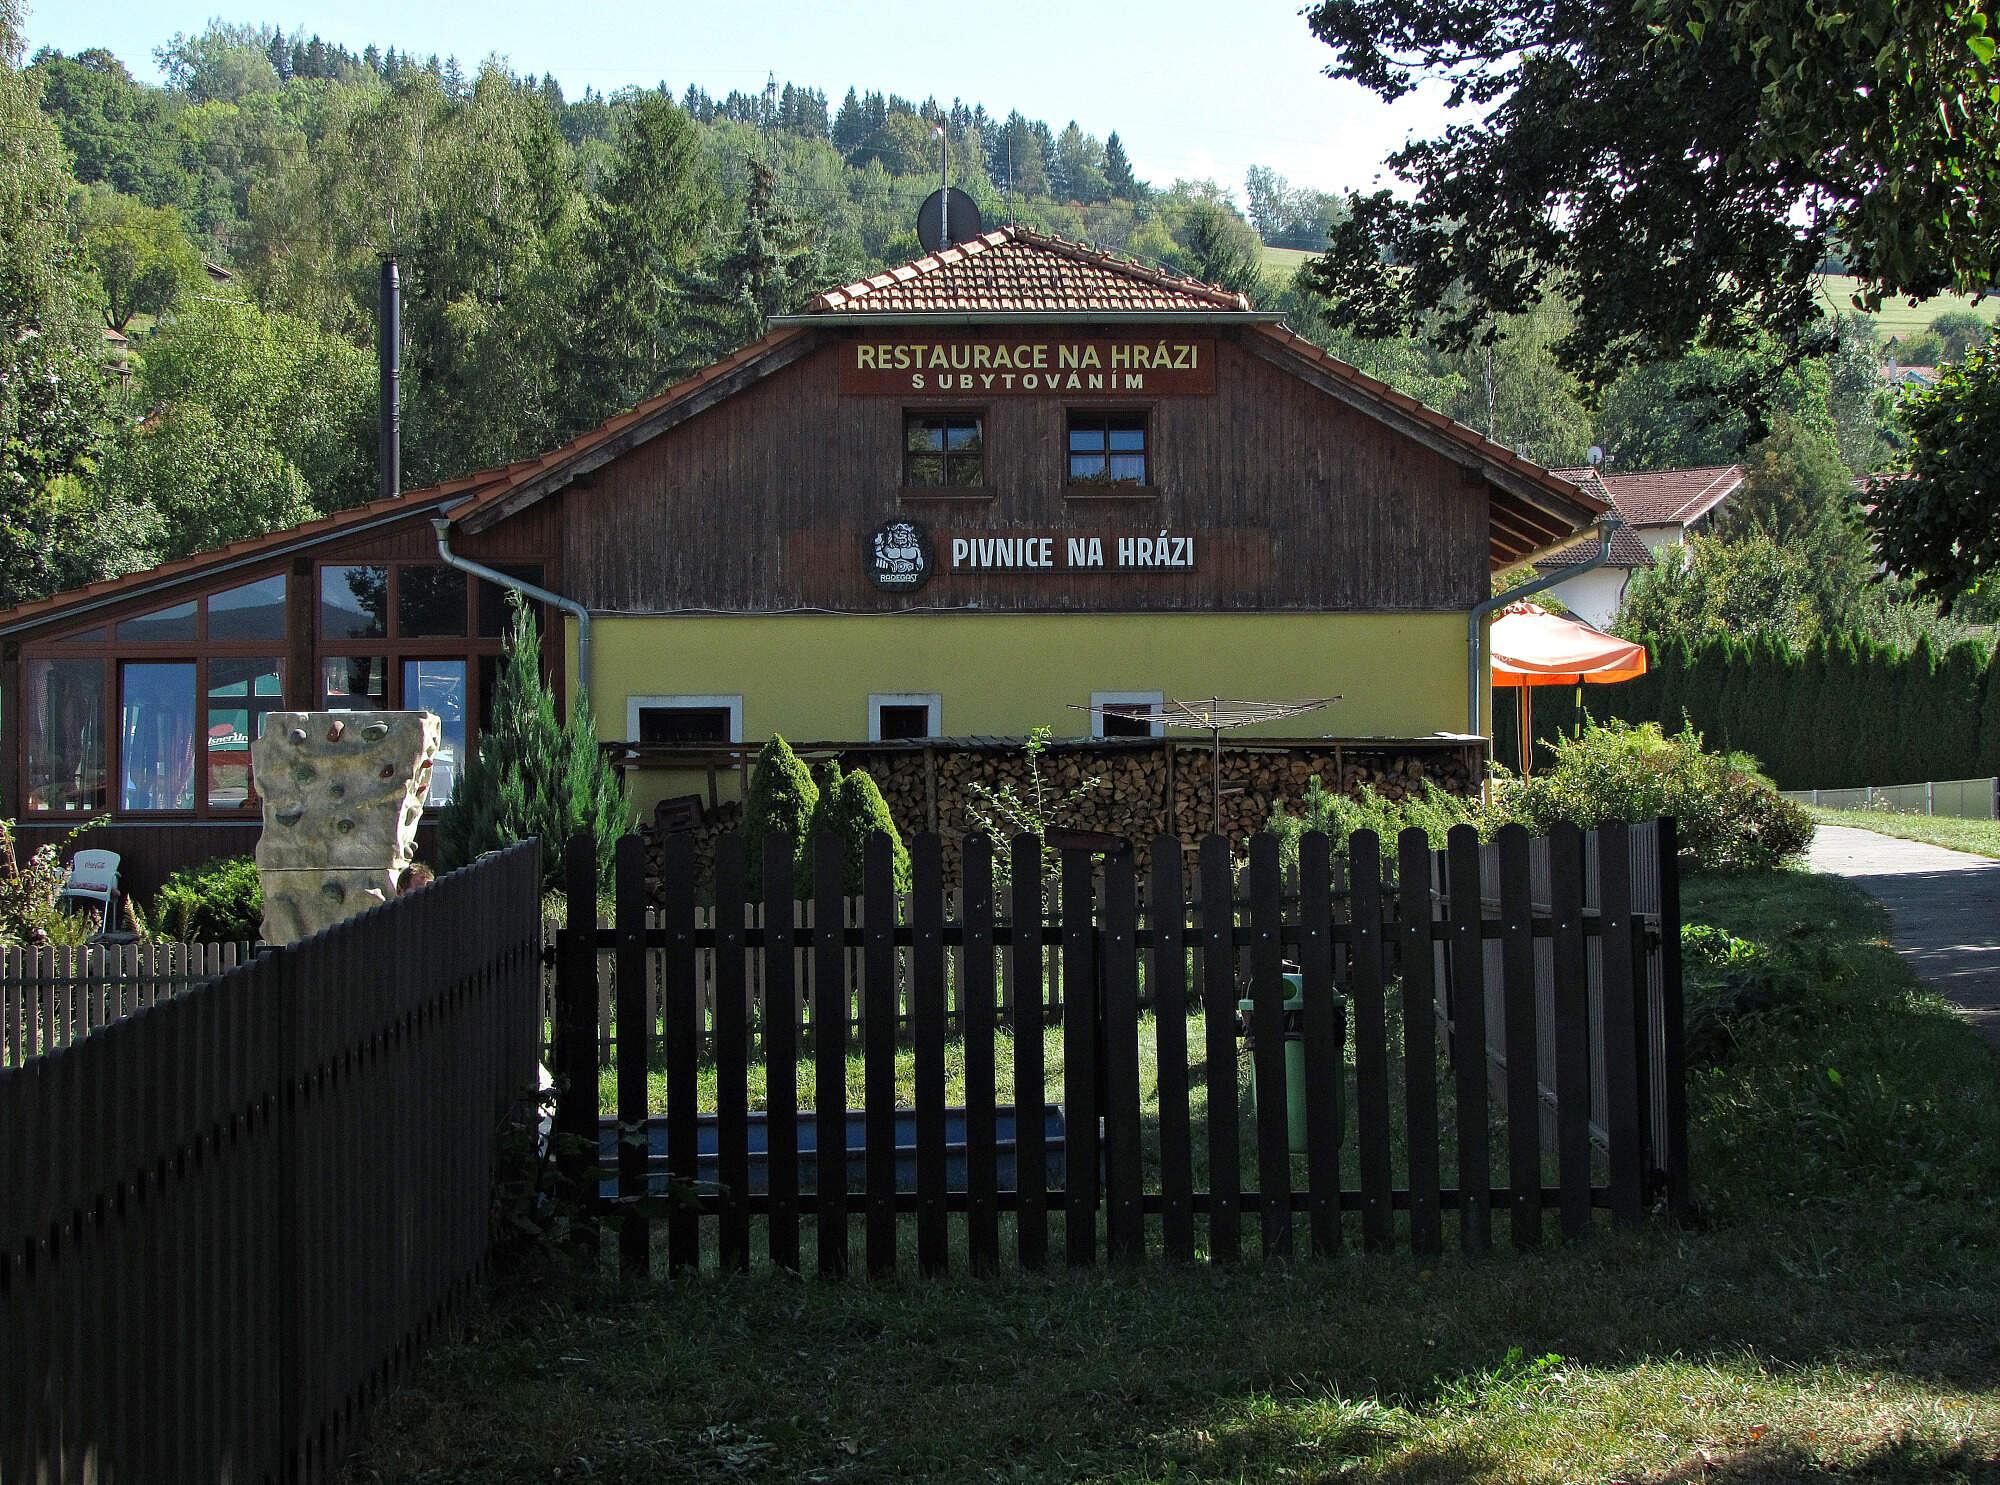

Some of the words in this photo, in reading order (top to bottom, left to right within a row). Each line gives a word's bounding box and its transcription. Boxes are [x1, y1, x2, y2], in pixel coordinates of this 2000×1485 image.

[857, 344, 1048, 369] RESTAURACE
[1058, 344, 1102, 369] NA
[1111, 340, 1198, 369] HRÁZI
[911, 373, 925, 389] S
[938, 370, 1144, 389] UBYTOVÁNÍM
[952, 537, 1053, 567] PIVNICE
[1067, 537, 1104, 566] NA
[1118, 529, 1194, 566] HRÁZI
[880, 573, 919, 583] RADEGAST
